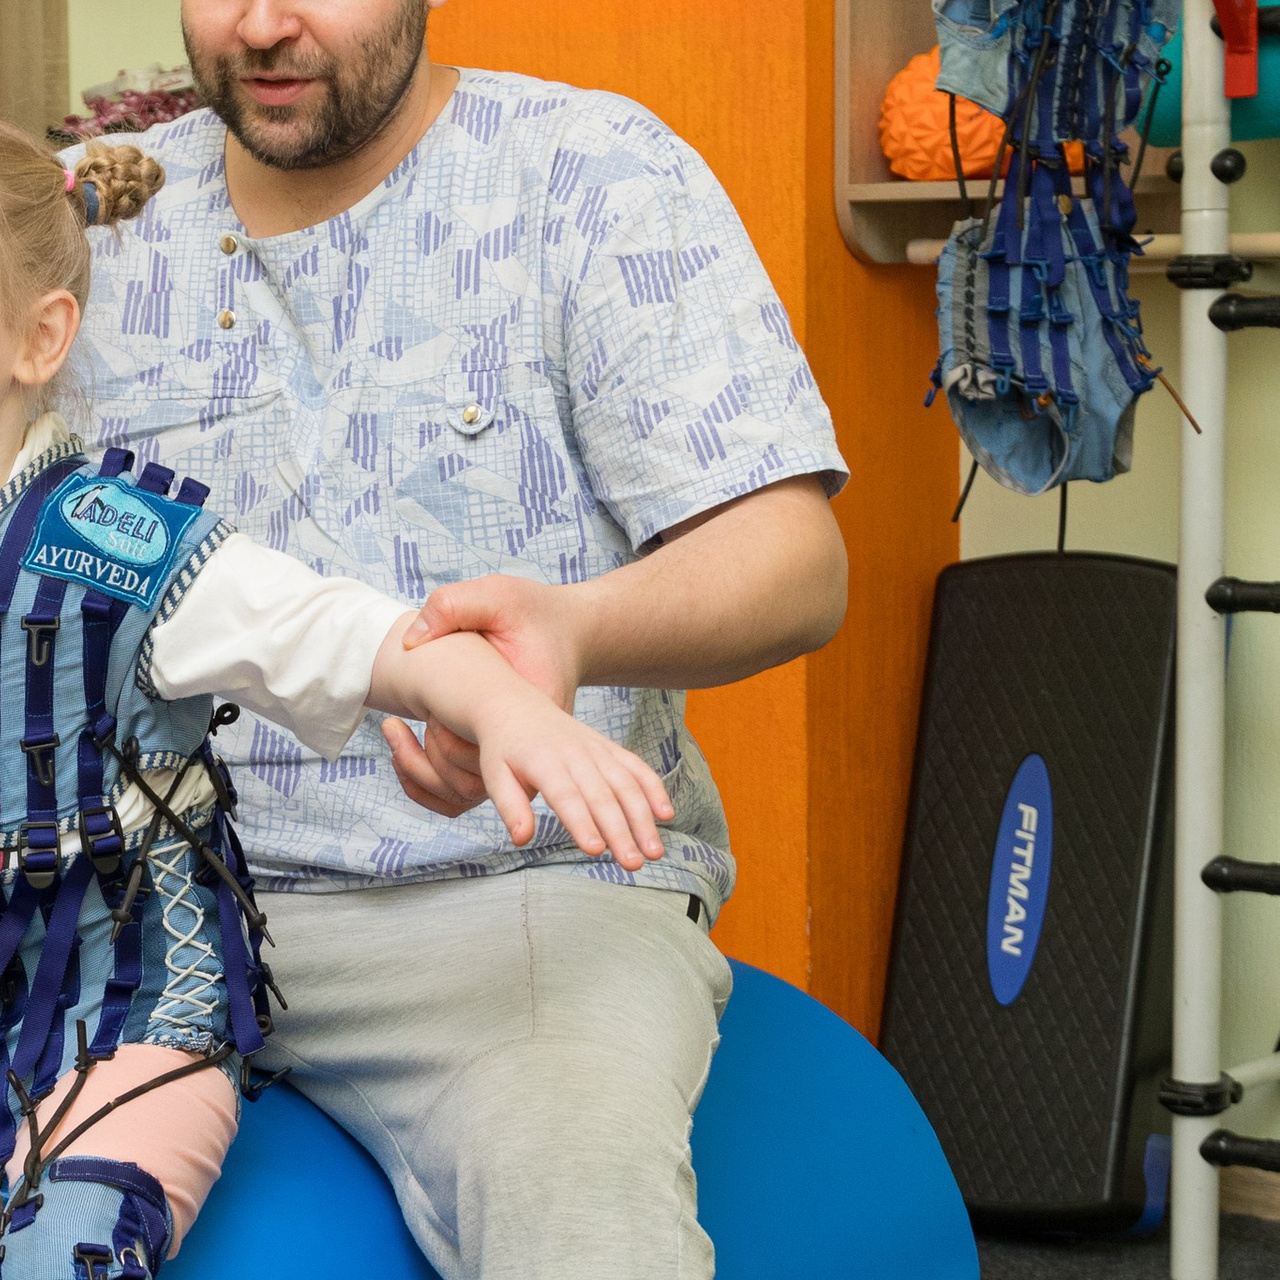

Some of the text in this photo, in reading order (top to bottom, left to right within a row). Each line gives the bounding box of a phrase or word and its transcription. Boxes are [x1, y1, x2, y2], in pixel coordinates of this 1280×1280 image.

[79, 502, 159, 543] ADELI
[106, 531, 149, 560] Suit
[33, 544, 151, 597] AYURVEDA
[1001, 803, 1039, 957] FITMAN
